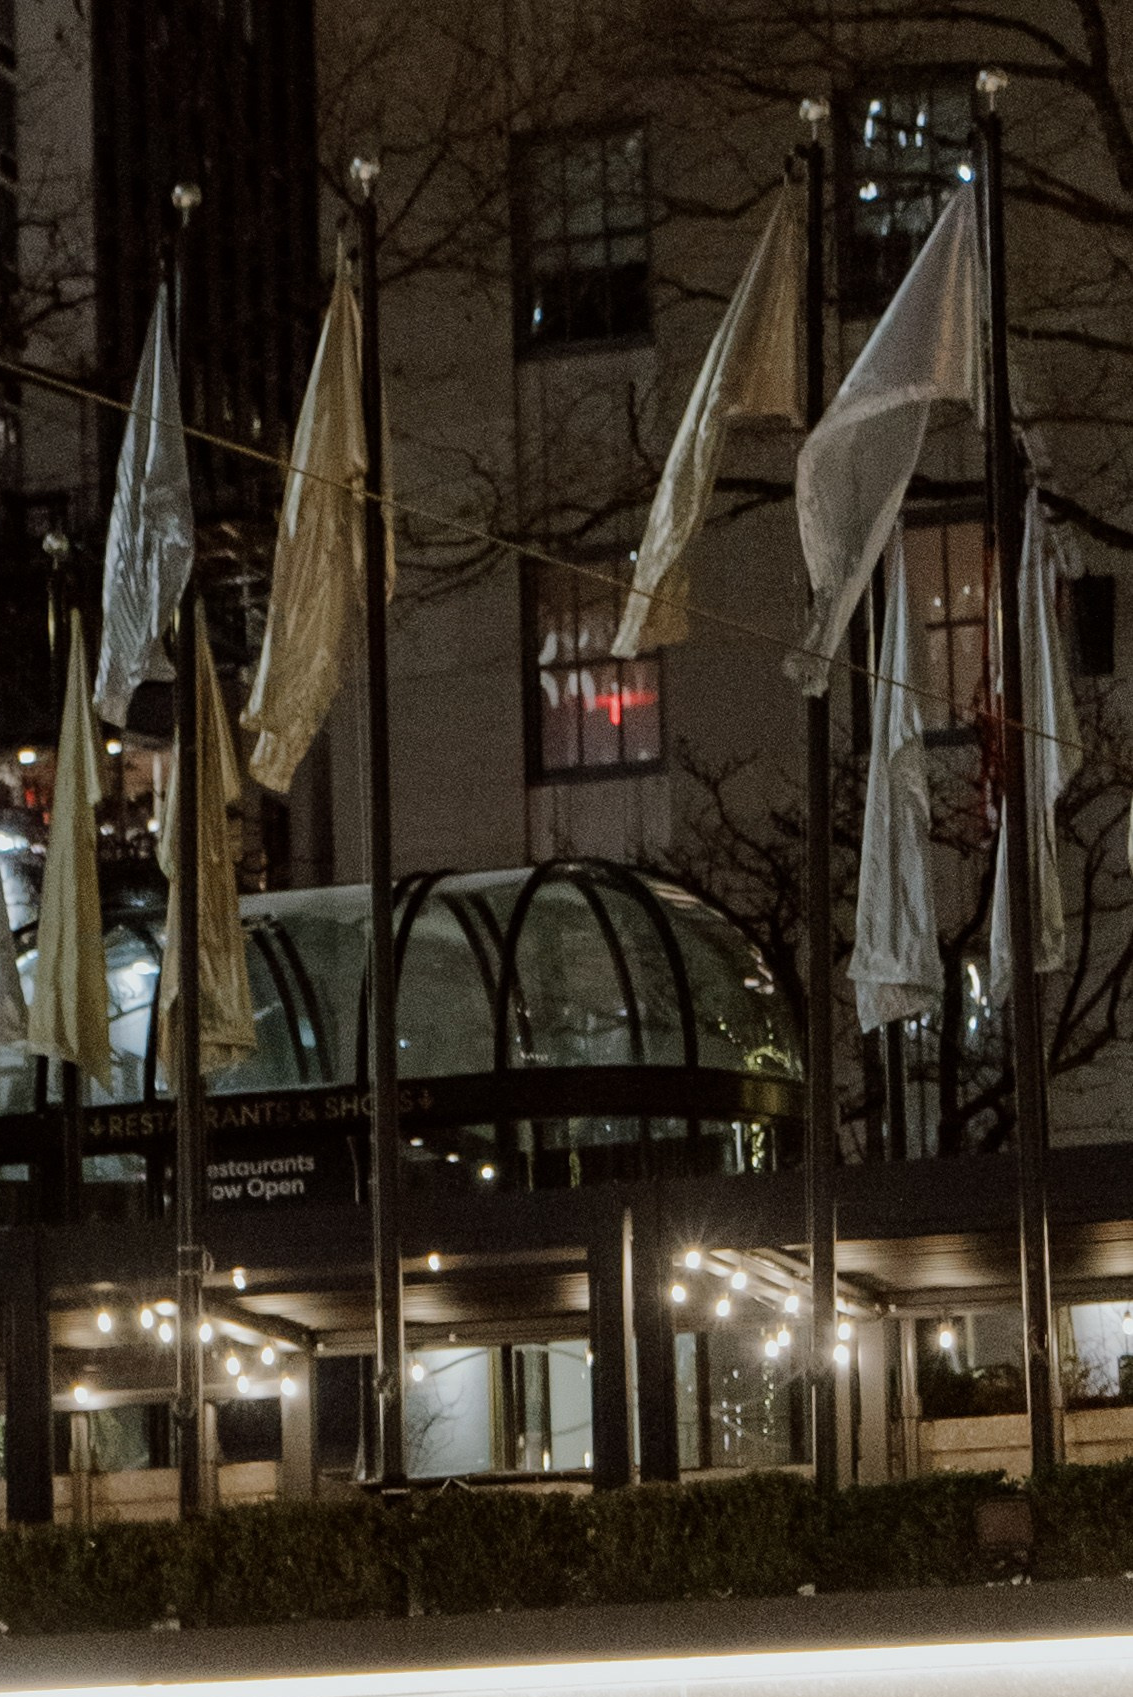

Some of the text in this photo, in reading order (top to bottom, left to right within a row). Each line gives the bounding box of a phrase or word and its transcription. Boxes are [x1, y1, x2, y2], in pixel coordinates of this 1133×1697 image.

[109, 1100, 291, 1137] RESTRANTS
[325, 1089, 414, 1119] SHS
[205, 1154, 316, 1180] estaurants
[208, 1178, 306, 1202] ow Open
